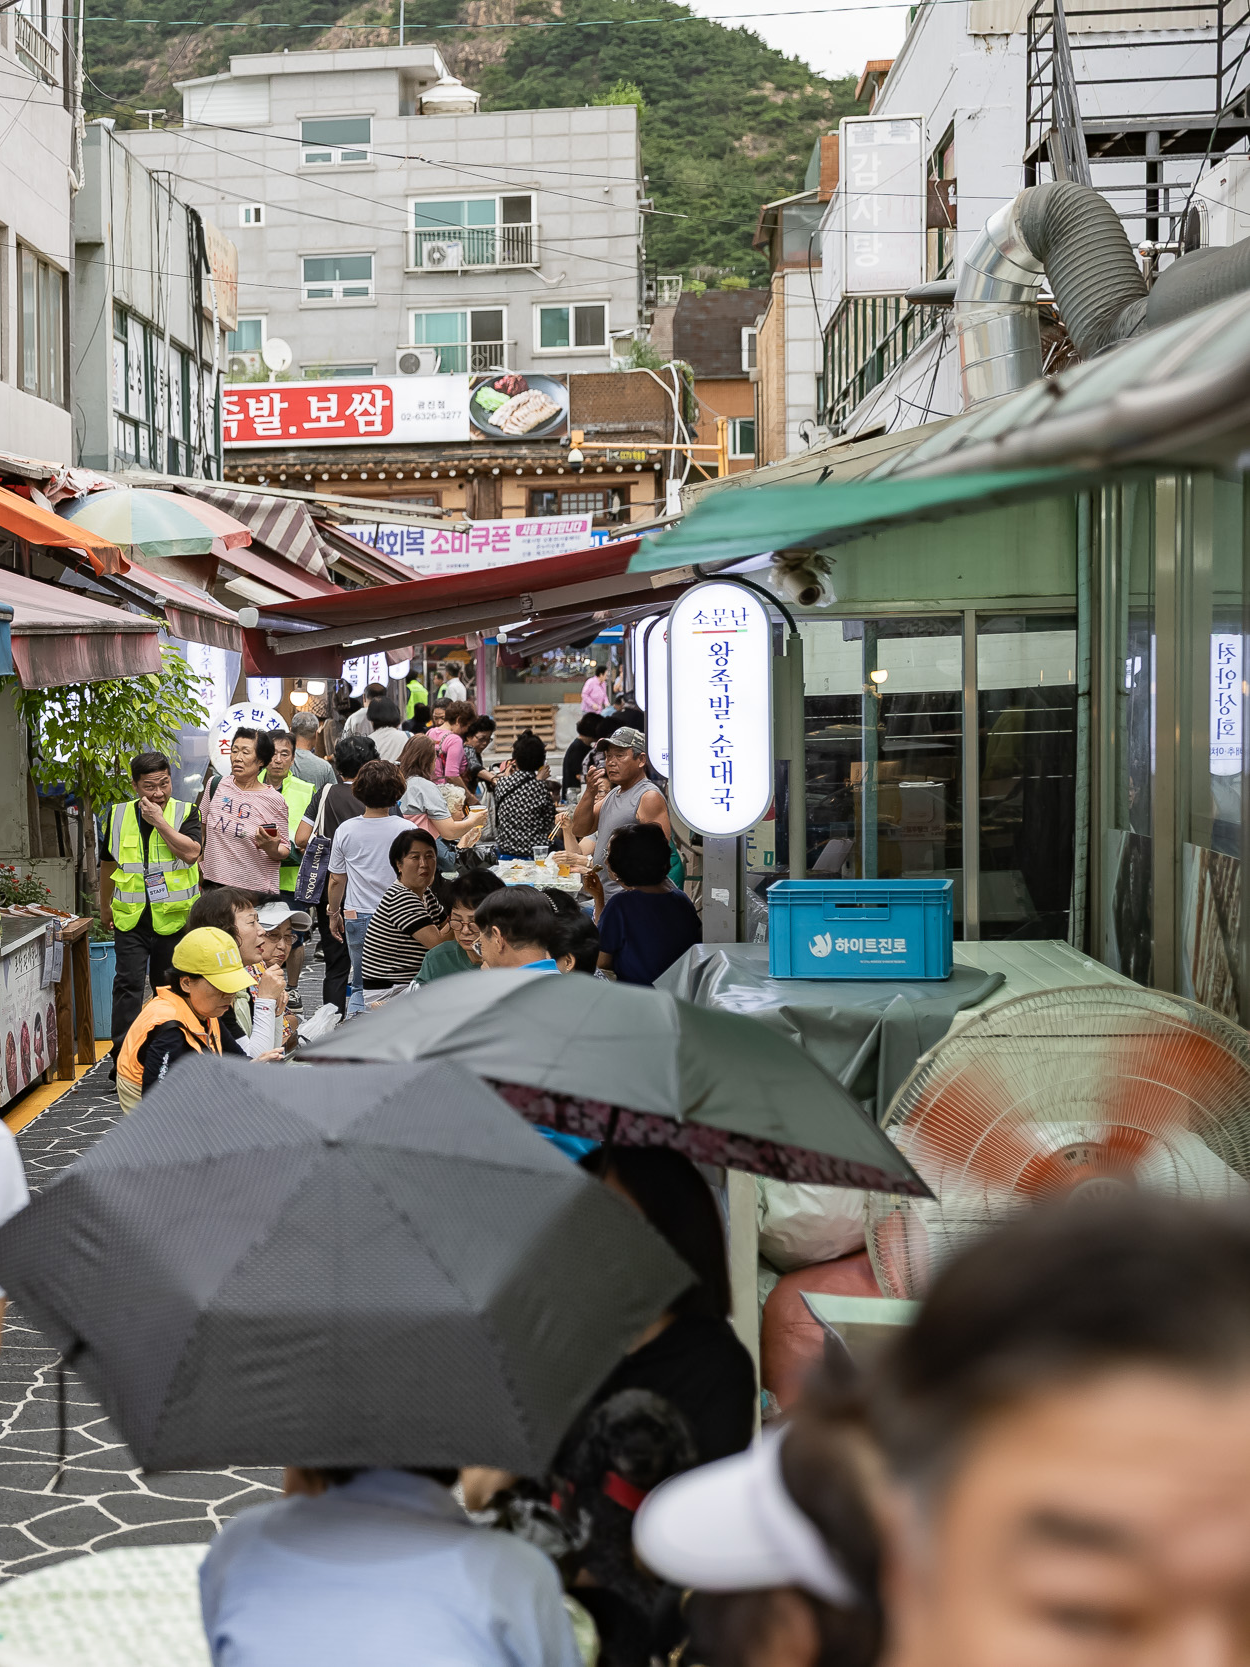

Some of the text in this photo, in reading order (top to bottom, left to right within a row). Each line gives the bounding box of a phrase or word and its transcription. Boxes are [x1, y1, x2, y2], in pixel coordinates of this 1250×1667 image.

[430, 525, 511, 555] 소비쿠폰
[691, 606, 750, 627] 소문난
[707, 640, 735, 812] 왕족발·순대국
[305, 843, 325, 900] DAUNT BOOKS
[150, 887, 165, 896] STAFF
[835, 937, 907, 955] 하이트진로
